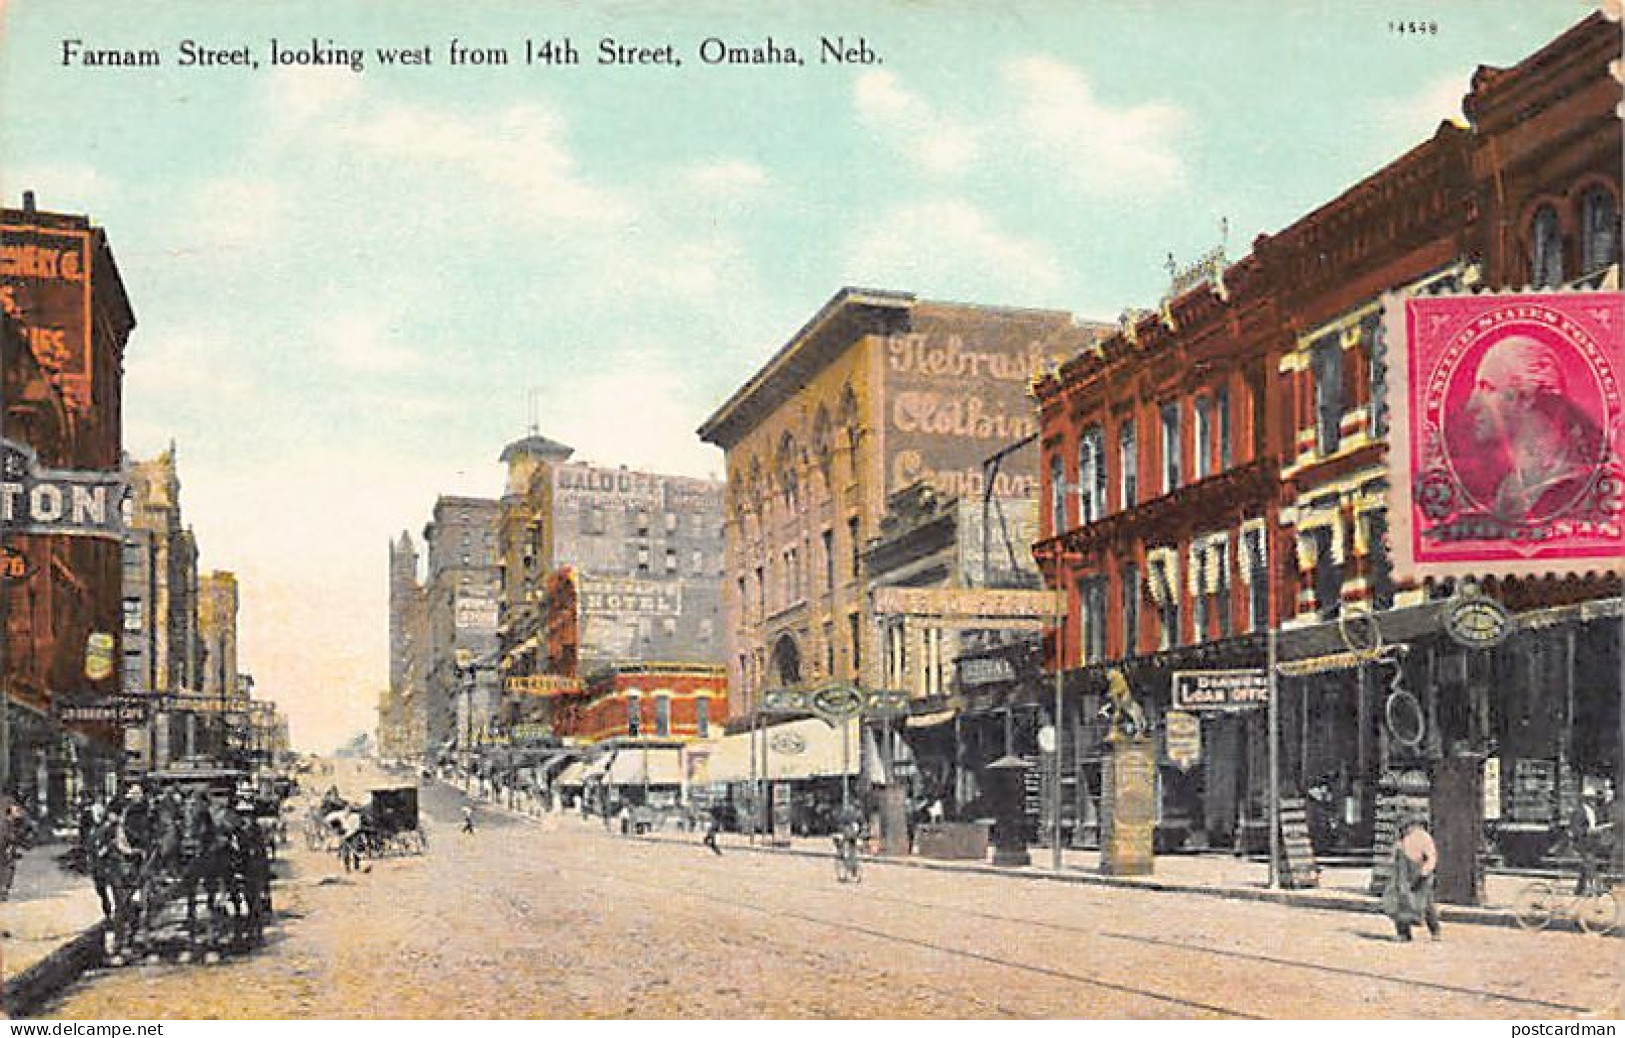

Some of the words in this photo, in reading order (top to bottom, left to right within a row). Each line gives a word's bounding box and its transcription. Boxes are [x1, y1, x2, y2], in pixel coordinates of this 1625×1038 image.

[62, 40, 160, 66] Farnam
[178, 40, 259, 69] Street,
[271, 39, 364, 71] looking
[376, 47, 431, 65] west
[450, 39, 507, 65] from
[526, 39, 579, 65] 14th
[598, 39, 681, 69] Street,
[699, 38, 804, 68] Omaha,
[821, 37, 883, 65] Neb.
[888, 333, 1044, 380] Nebrask
[893, 391, 1035, 438] Clothin
[893, 450, 1037, 496] Compan
[1181, 683, 1226, 702] LOAN
